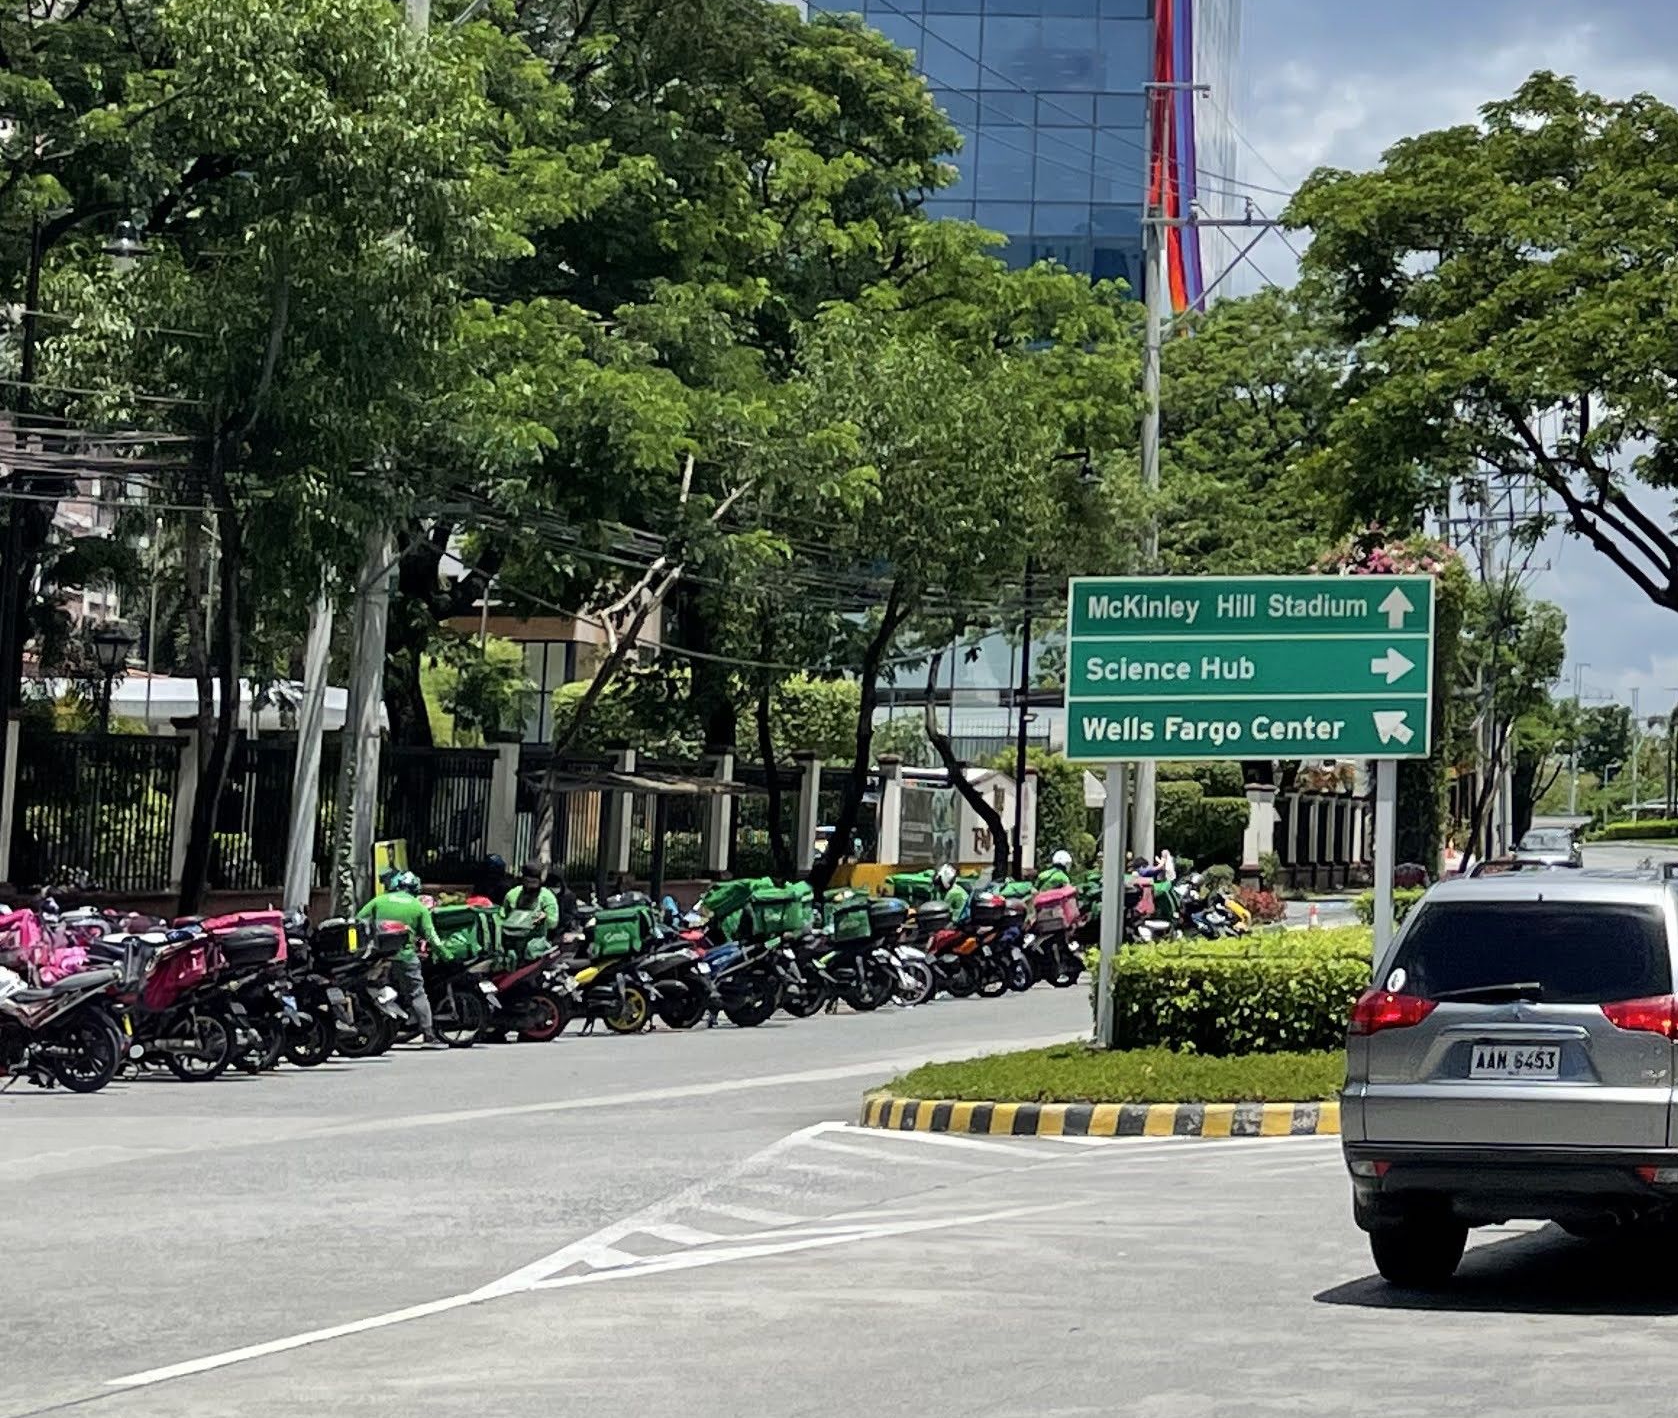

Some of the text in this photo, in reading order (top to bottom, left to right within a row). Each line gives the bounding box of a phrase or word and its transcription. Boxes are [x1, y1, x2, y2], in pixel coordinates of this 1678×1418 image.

[1088, 593, 1368, 624] McKinley Hill Stadium
[1086, 655, 1256, 681] Science Hub
[1082, 716, 1346, 746] Wells Fargo Center
[1513, 1050, 1556, 1070] 6453
